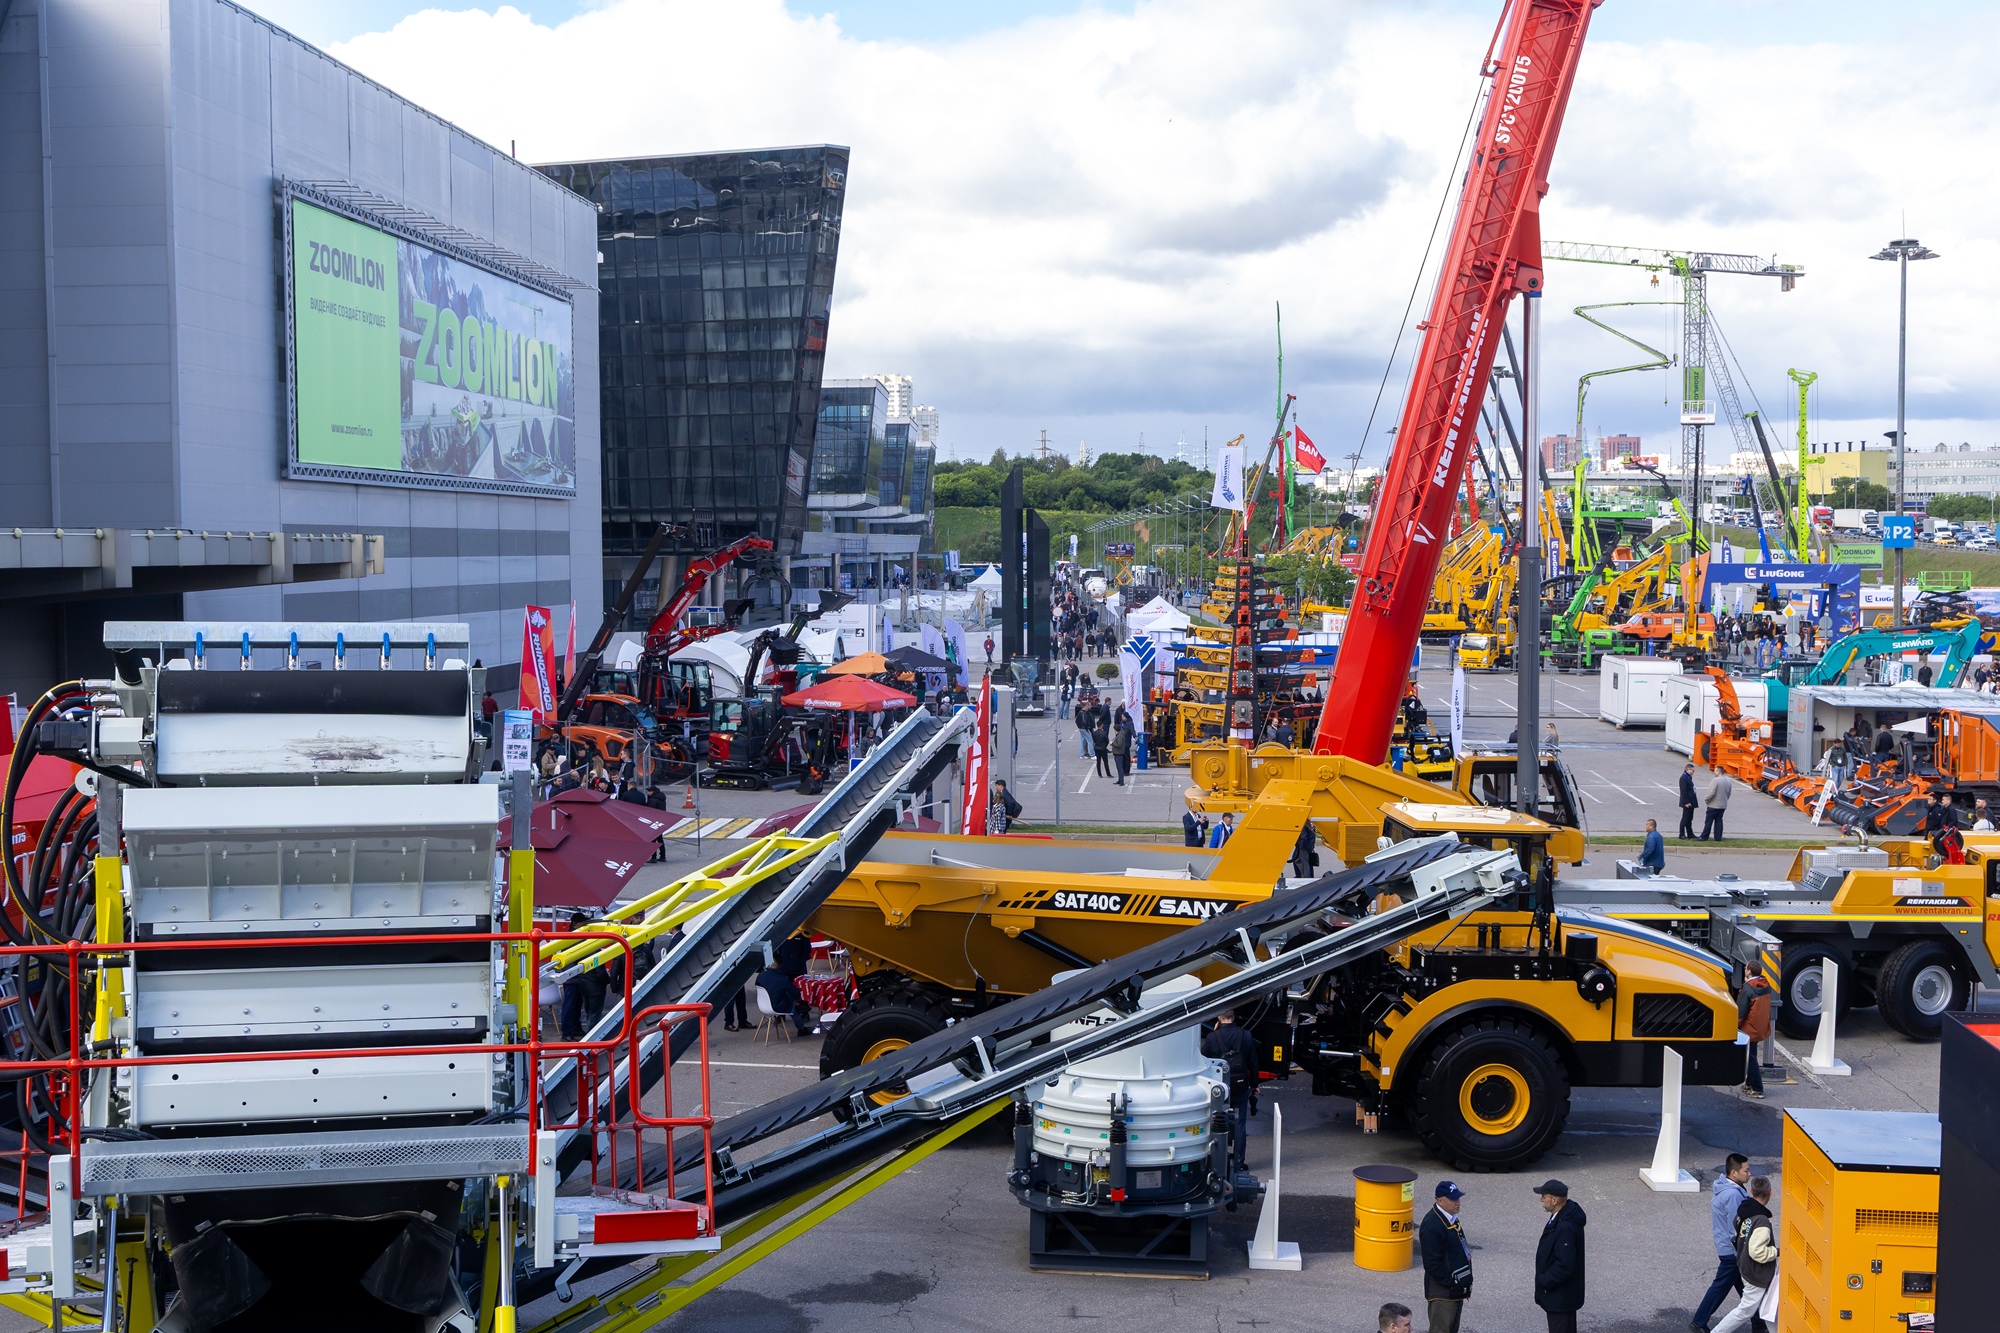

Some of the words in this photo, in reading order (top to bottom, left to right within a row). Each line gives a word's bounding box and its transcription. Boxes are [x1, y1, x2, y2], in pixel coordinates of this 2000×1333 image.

[1495, 55, 1532, 144] STC1200T5
[309, 241, 385, 291] ZOOMLION
[310, 297, 337, 316] ВИДЕНИЕ
[362, 311, 386, 328] БУДУЩЕЕ
[413, 298, 558, 410] ZOOMLION
[331, 423, 373, 437] www.zoomlion.ru
[1298, 440, 1321, 460] SAN
[1893, 526, 1912, 539] P2
[1892, 637, 1934, 649] SUNWARD
[1054, 892, 1121, 912] SAT40C
[1159, 898, 1228, 917] SANY
[1895, 907, 1973, 915] www.rentakran.ru
